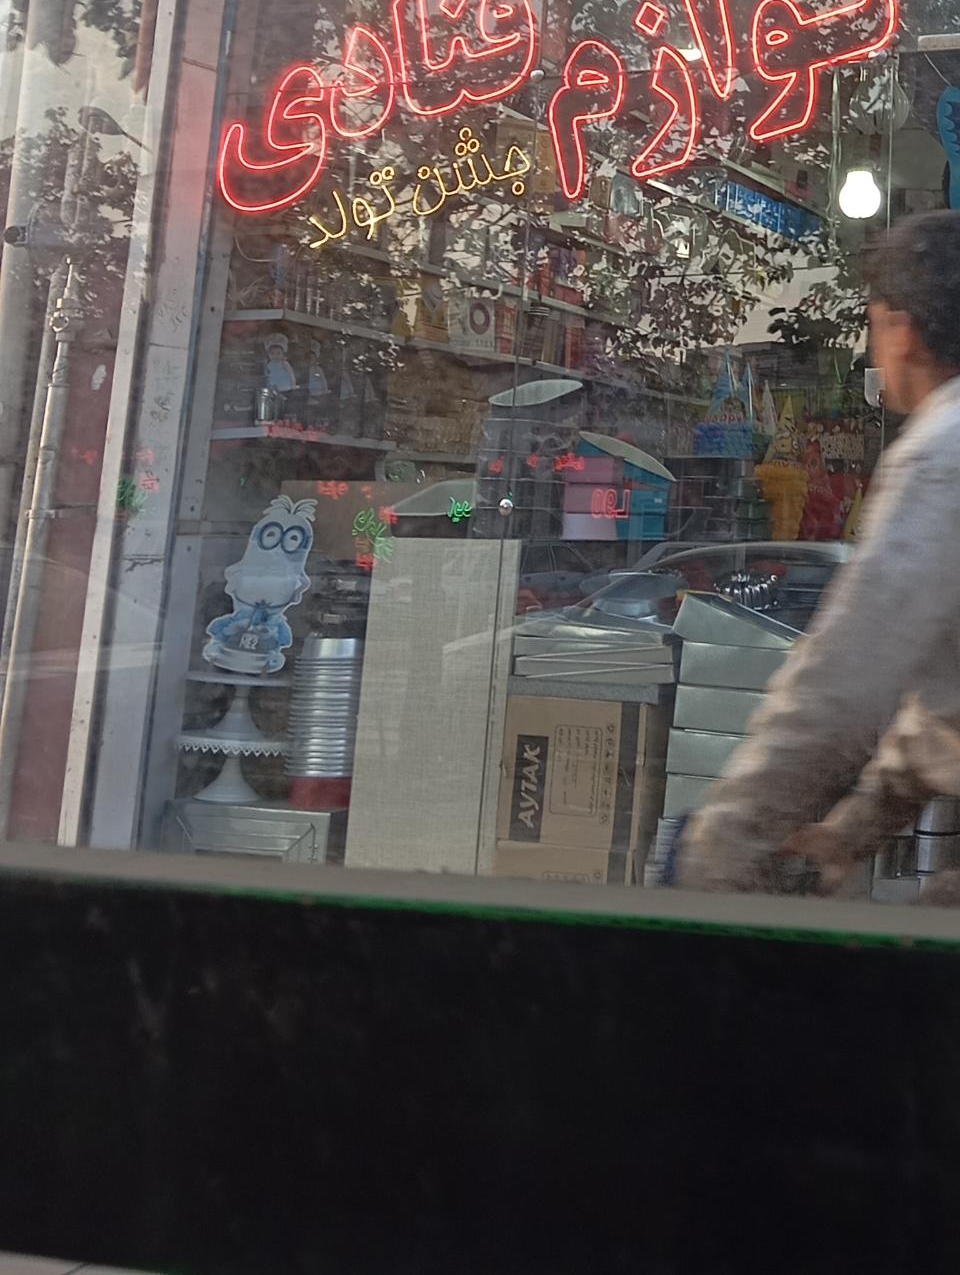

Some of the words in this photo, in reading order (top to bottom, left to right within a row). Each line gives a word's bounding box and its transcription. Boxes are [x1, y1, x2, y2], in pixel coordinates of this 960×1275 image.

[308, 166, 396, 248] تولد
[410, 127, 532, 217] جشن
[516, 742, 541, 829] AYTAK
